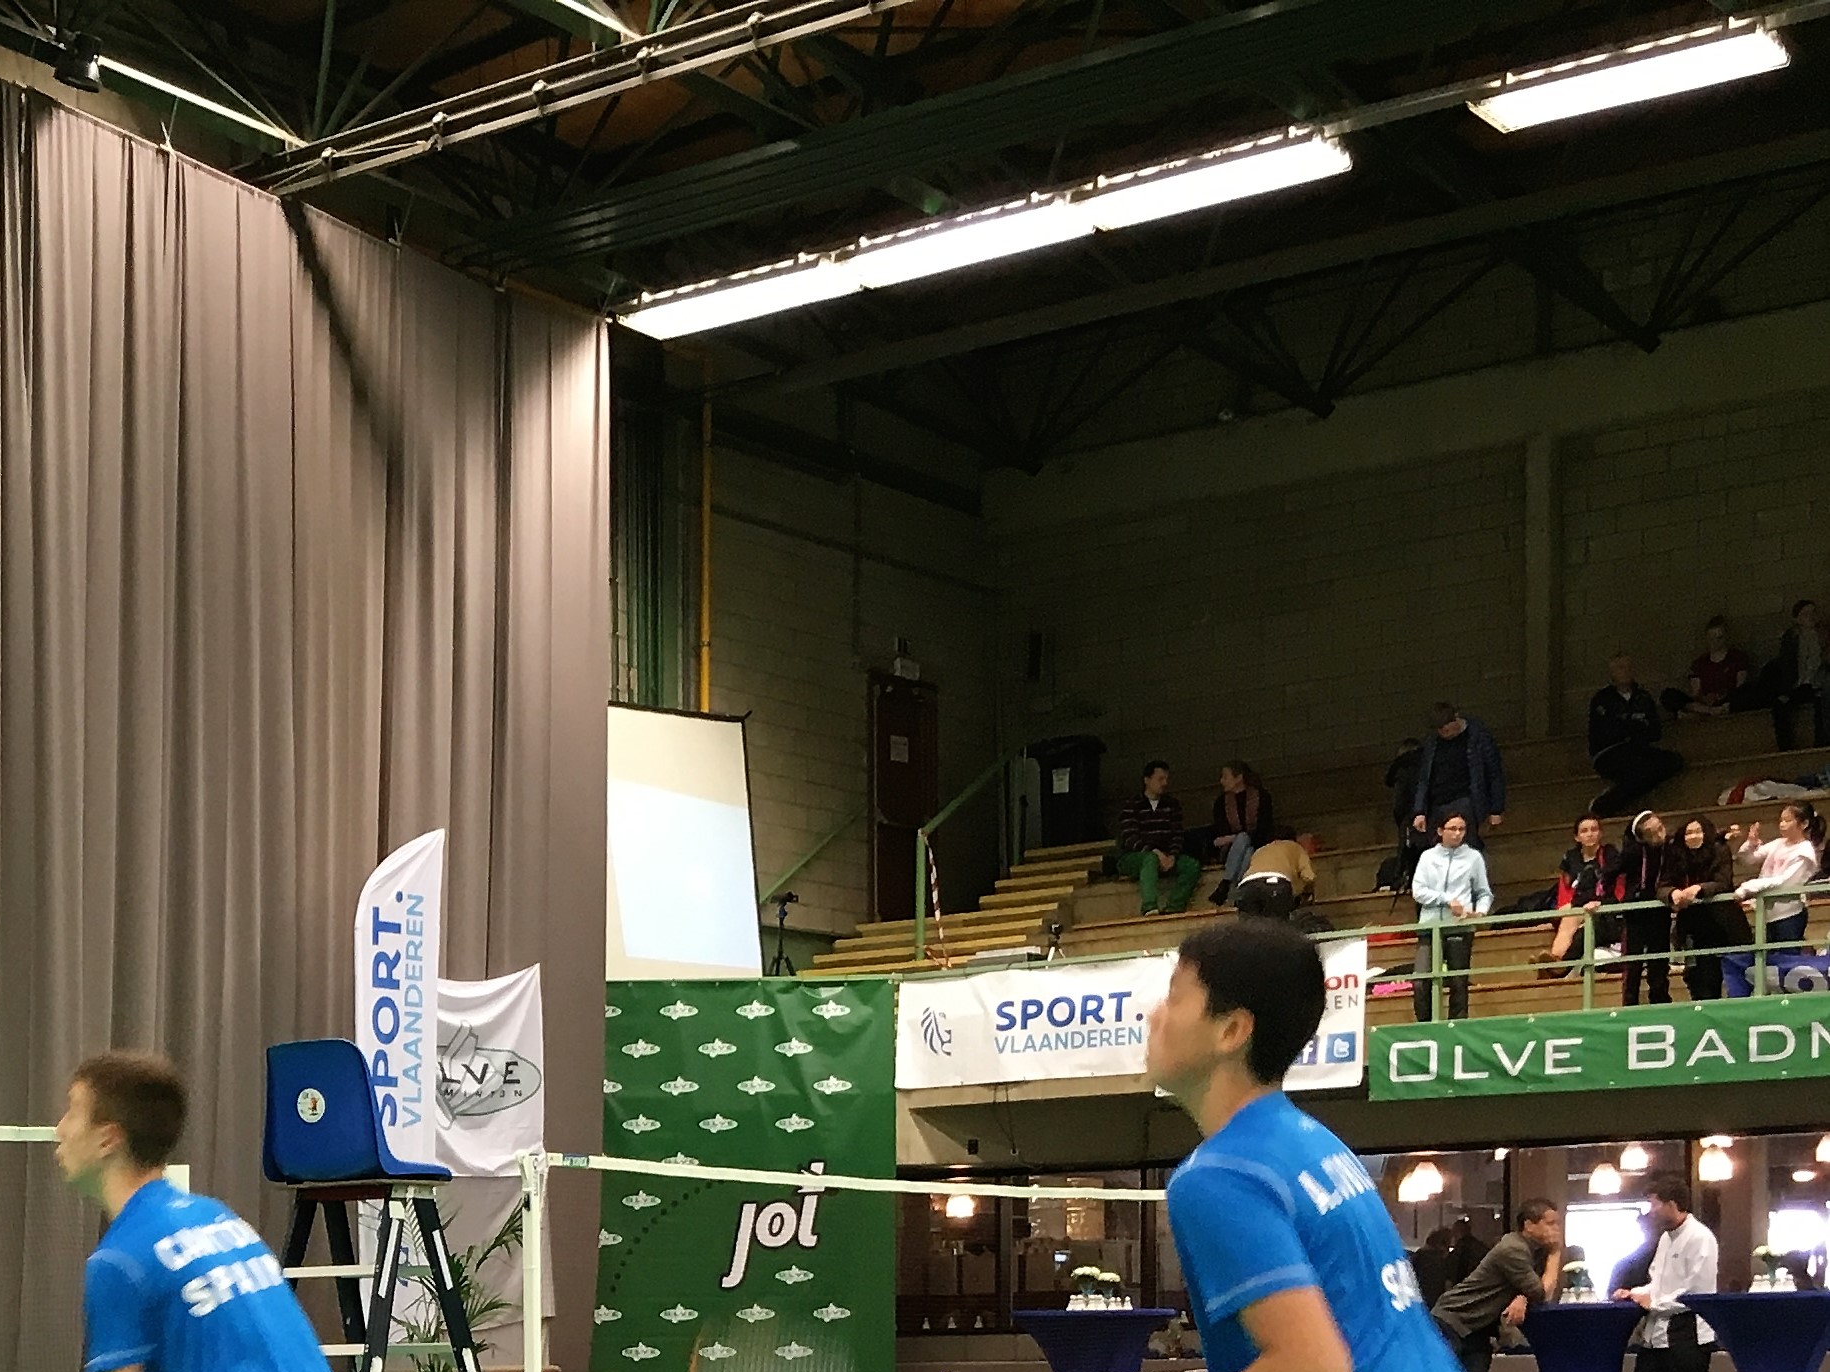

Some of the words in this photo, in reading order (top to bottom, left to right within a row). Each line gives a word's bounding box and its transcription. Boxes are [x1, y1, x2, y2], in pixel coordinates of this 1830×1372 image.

[371, 890, 404, 1127] SPORT.
[401, 893, 425, 1128] VLAANDEREN
[995, 990, 1145, 1032] SPORT.
[1325, 994, 1359, 1011] EN
[993, 1025, 1144, 1055] VLAANDEREN
[1388, 1037, 1583, 1083] OLVE
